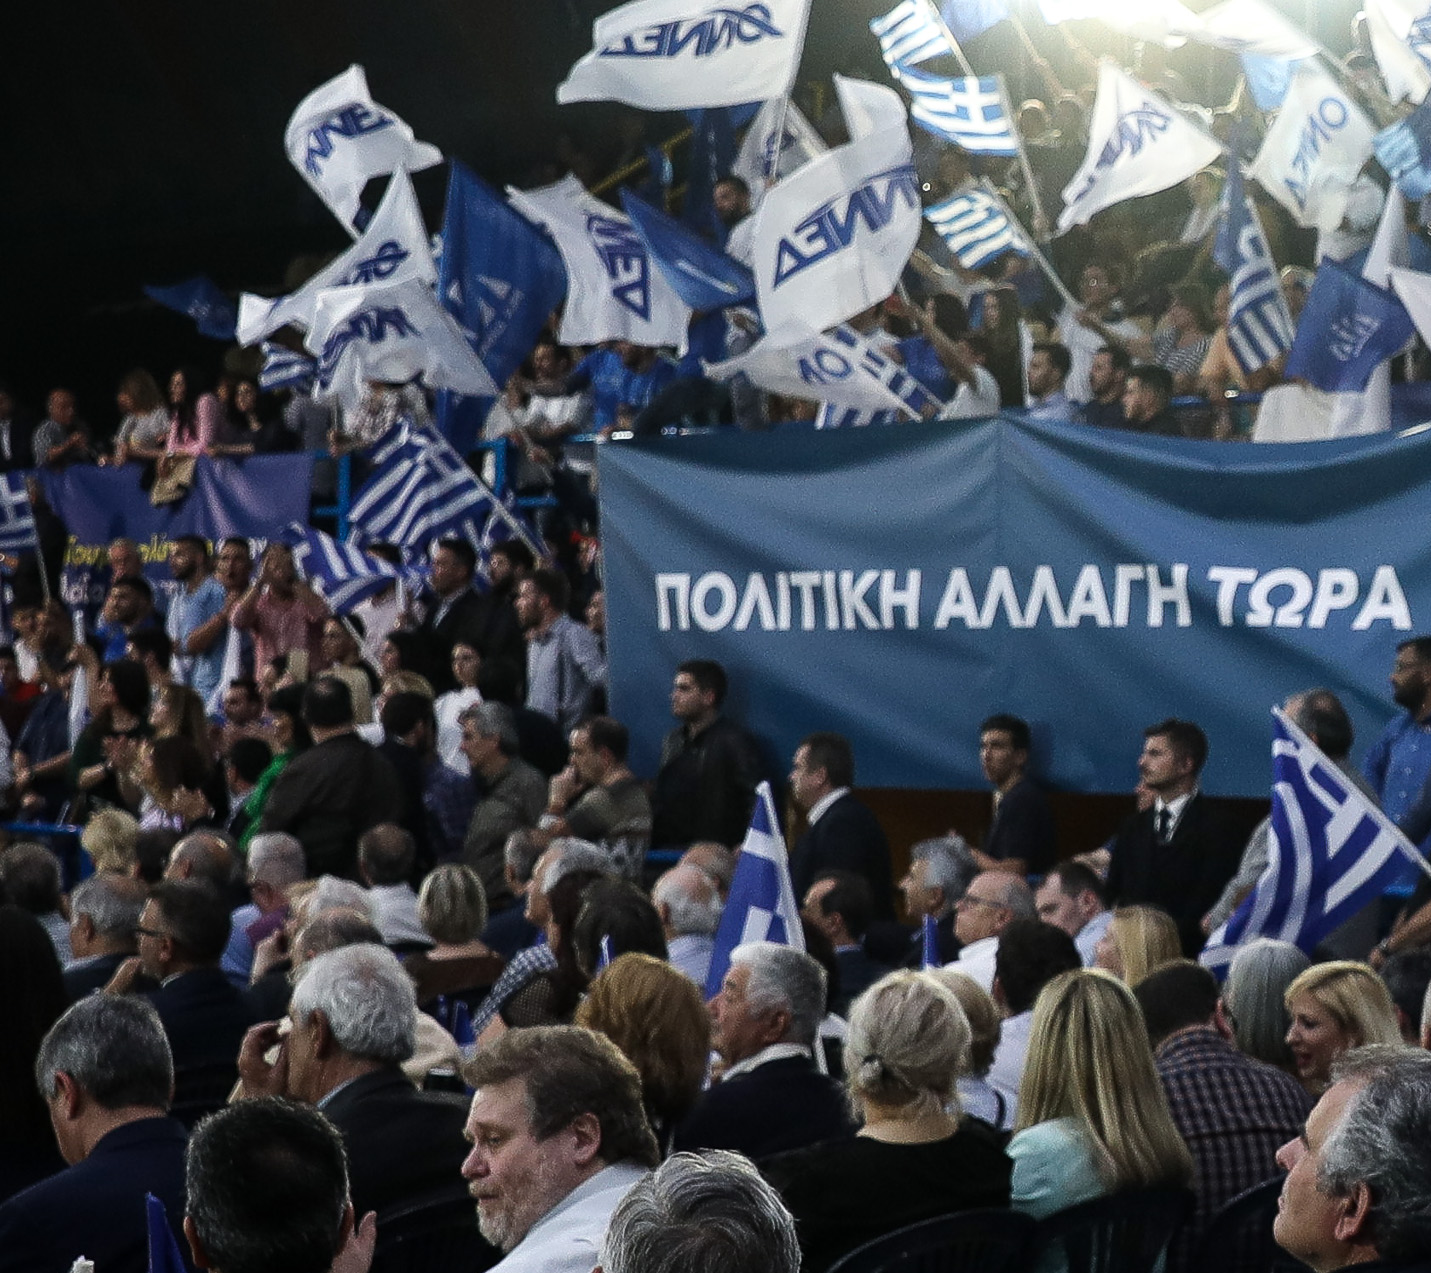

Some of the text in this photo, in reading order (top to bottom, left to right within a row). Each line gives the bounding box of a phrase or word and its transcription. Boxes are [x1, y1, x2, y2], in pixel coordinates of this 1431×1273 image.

[655, 564, 1413, 632] ΠΟΛΙΤΙΚΗ ΑΛΛΑΓΗ ΤΩΡΑ
